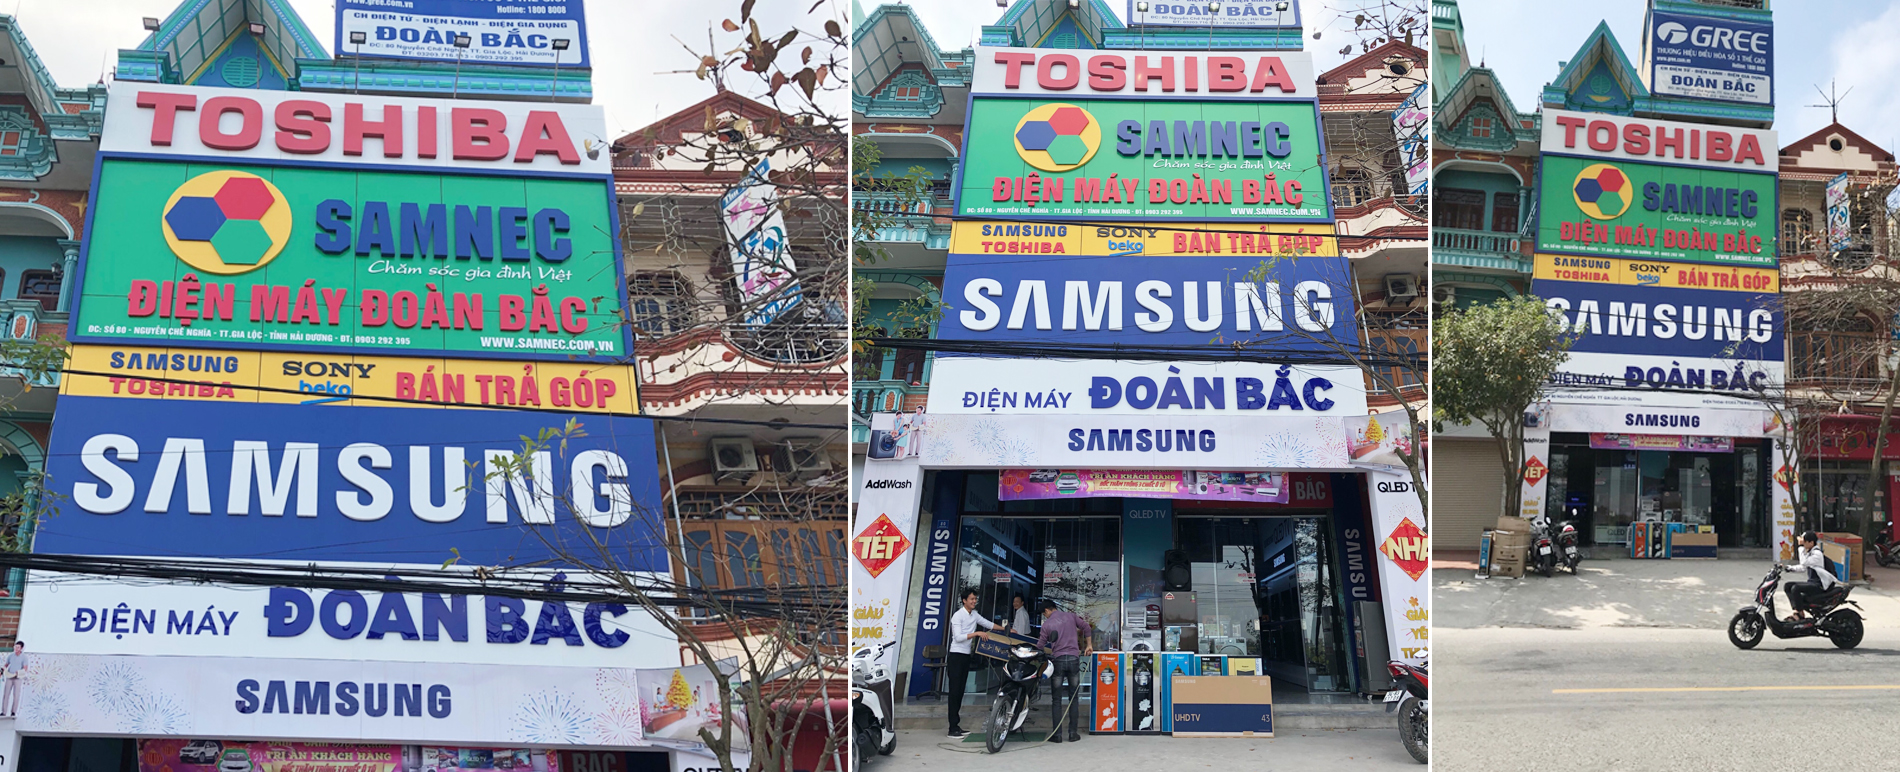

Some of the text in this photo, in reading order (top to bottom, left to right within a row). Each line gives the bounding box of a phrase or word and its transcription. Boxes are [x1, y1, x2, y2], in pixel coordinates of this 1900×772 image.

[1155, 3, 1273, 16] ĐOÀN BẮC
[375, 26, 548, 49] ĐOÀN BẮC
[1690, 25, 1770, 55] GREE
[994, 51, 1297, 93] TOSHIBA
[1671, 75, 1717, 89] ĐOÀN
[1722, 77, 1756, 93] BẮC
[136, 91, 581, 166] TOSHIBA
[1116, 119, 1292, 158] SAMNEC
[1556, 116, 1766, 165] TOSHIBA
[1153, 159, 1292, 171] Chăm sóc gia đình Việt
[992, 171, 1303, 207] ĐIỆN MÁY ĐOÀN BẮC
[1643, 181, 1758, 219] SAMNEC
[315, 198, 573, 264] SAMNEC
[982, 224, 1067, 237] SAMSUNG
[1097, 227, 1159, 238] SONY
[1173, 225, 1324, 254] BÁN TRẢ GÓP
[1559, 219, 1609, 247] ĐIỆN
[1614, 223, 1658, 247] MÁY
[1663, 227, 1718, 252] ĐOÀN
[1723, 228, 1762, 255] BẮC
[982, 241, 1065, 253] TOSHIBA
[1108, 240, 1144, 251] beko
[367, 260, 573, 283] Chăm sóc gia đình Việt
[1554, 257, 1611, 269] SAMSUNG
[1629, 263, 1670, 274] SONY
[1554, 270, 1609, 281] TOSHIBA
[1678, 267, 1771, 290] BÁN TRẢ GÓP
[127, 273, 589, 336] ĐIỆN MÁY ĐOÀN BẮC
[959, 278, 1335, 333] SAMSUNG
[1545, 297, 1773, 343] SAMSUNG
[247, 330, 262, 340] LỘC
[305, 333, 333, 342] DƯƠNG
[480, 336, 614, 352] WWW.SAMNEC.COM.VN
[110, 351, 239, 374] SAMSUNG
[282, 361, 376, 379] SONY
[109, 376, 235, 398] TOSHIBA
[299, 379, 352, 396] beko
[396, 364, 617, 408] BÁN TRẢ GÓP
[962, 364, 1335, 412] ĐIỆN MÁY ĐOÀN BẮC
[1624, 361, 1706, 390] ĐOÀN
[1711, 361, 1767, 392] BẮC
[1625, 413, 1700, 427] SAMSUNG
[1067, 428, 1216, 453] SAMSUNG
[73, 434, 632, 528] SAMSUNG
[865, 480, 912, 488] AddWash
[1294, 474, 1326, 501] BẮC
[1378, 482, 1408, 493] QLED
[1129, 510, 1166, 518] QLED TV
[858, 525, 901, 560] TẾT
[1344, 528, 1367, 598] SAMSU
[922, 529, 950, 630] SAMSUNG
[72, 602, 161, 642] ĐIỆN
[166, 604, 239, 637] MÁY
[263, 576, 469, 643] ĐOÀN
[853, 605, 885, 620] GIÀU
[1406, 606, 1428, 621] GIÀ
[235, 679, 452, 718] SAMSUNG
[1175, 713, 1190, 722] UHD
